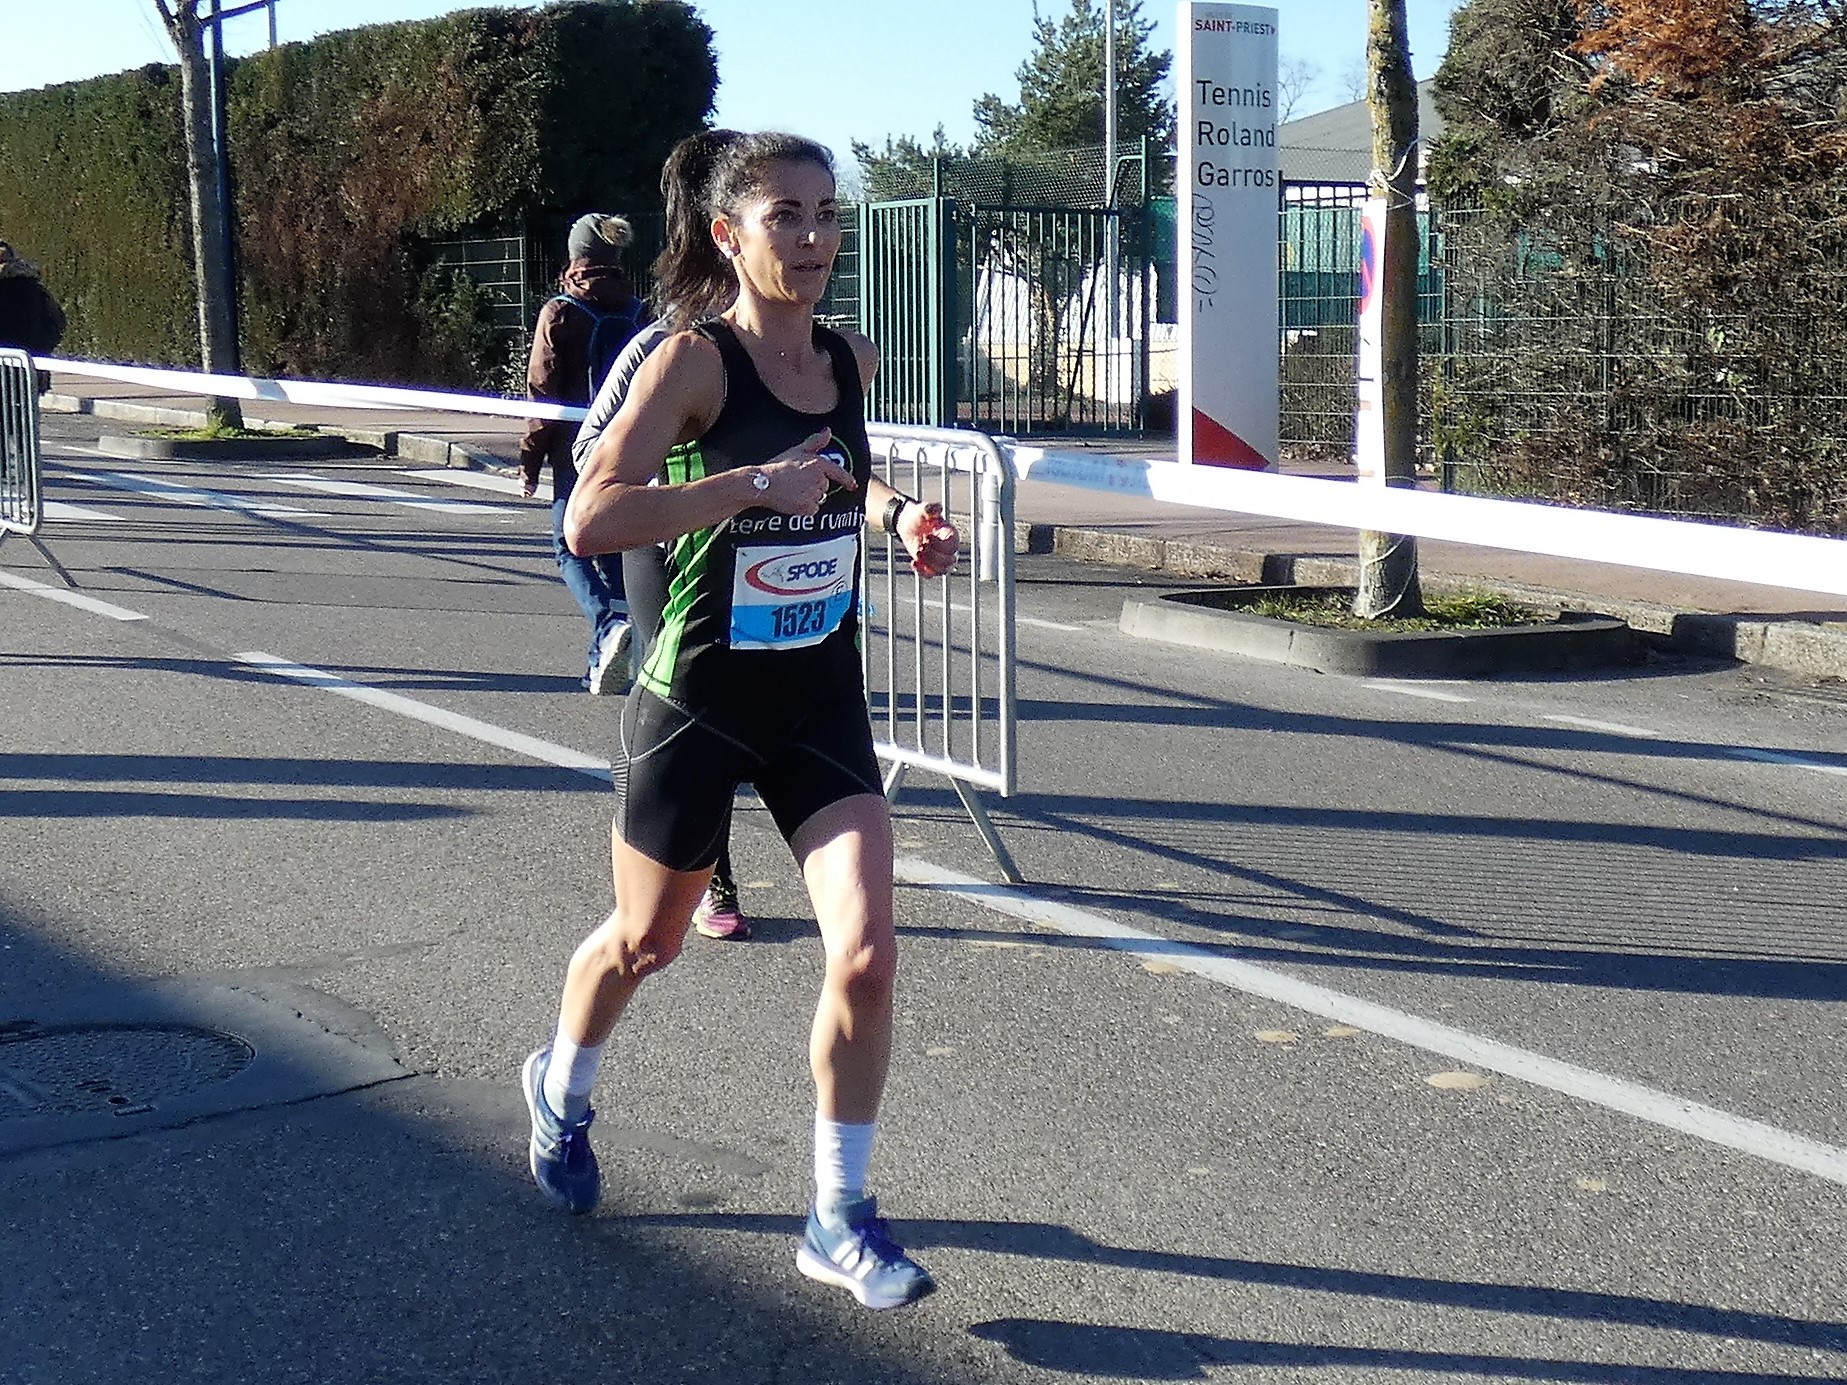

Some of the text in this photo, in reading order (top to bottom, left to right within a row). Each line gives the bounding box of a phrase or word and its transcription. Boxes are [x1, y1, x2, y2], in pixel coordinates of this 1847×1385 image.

[1195, 19, 1270, 35] SAINT-PRIEST
[1197, 80, 1270, 107] Tennis
[1198, 121, 1274, 147] Roland
[1198, 161, 1273, 187] Garros
[787, 559, 837, 581] SPODE
[771, 600, 826, 638] 1523
